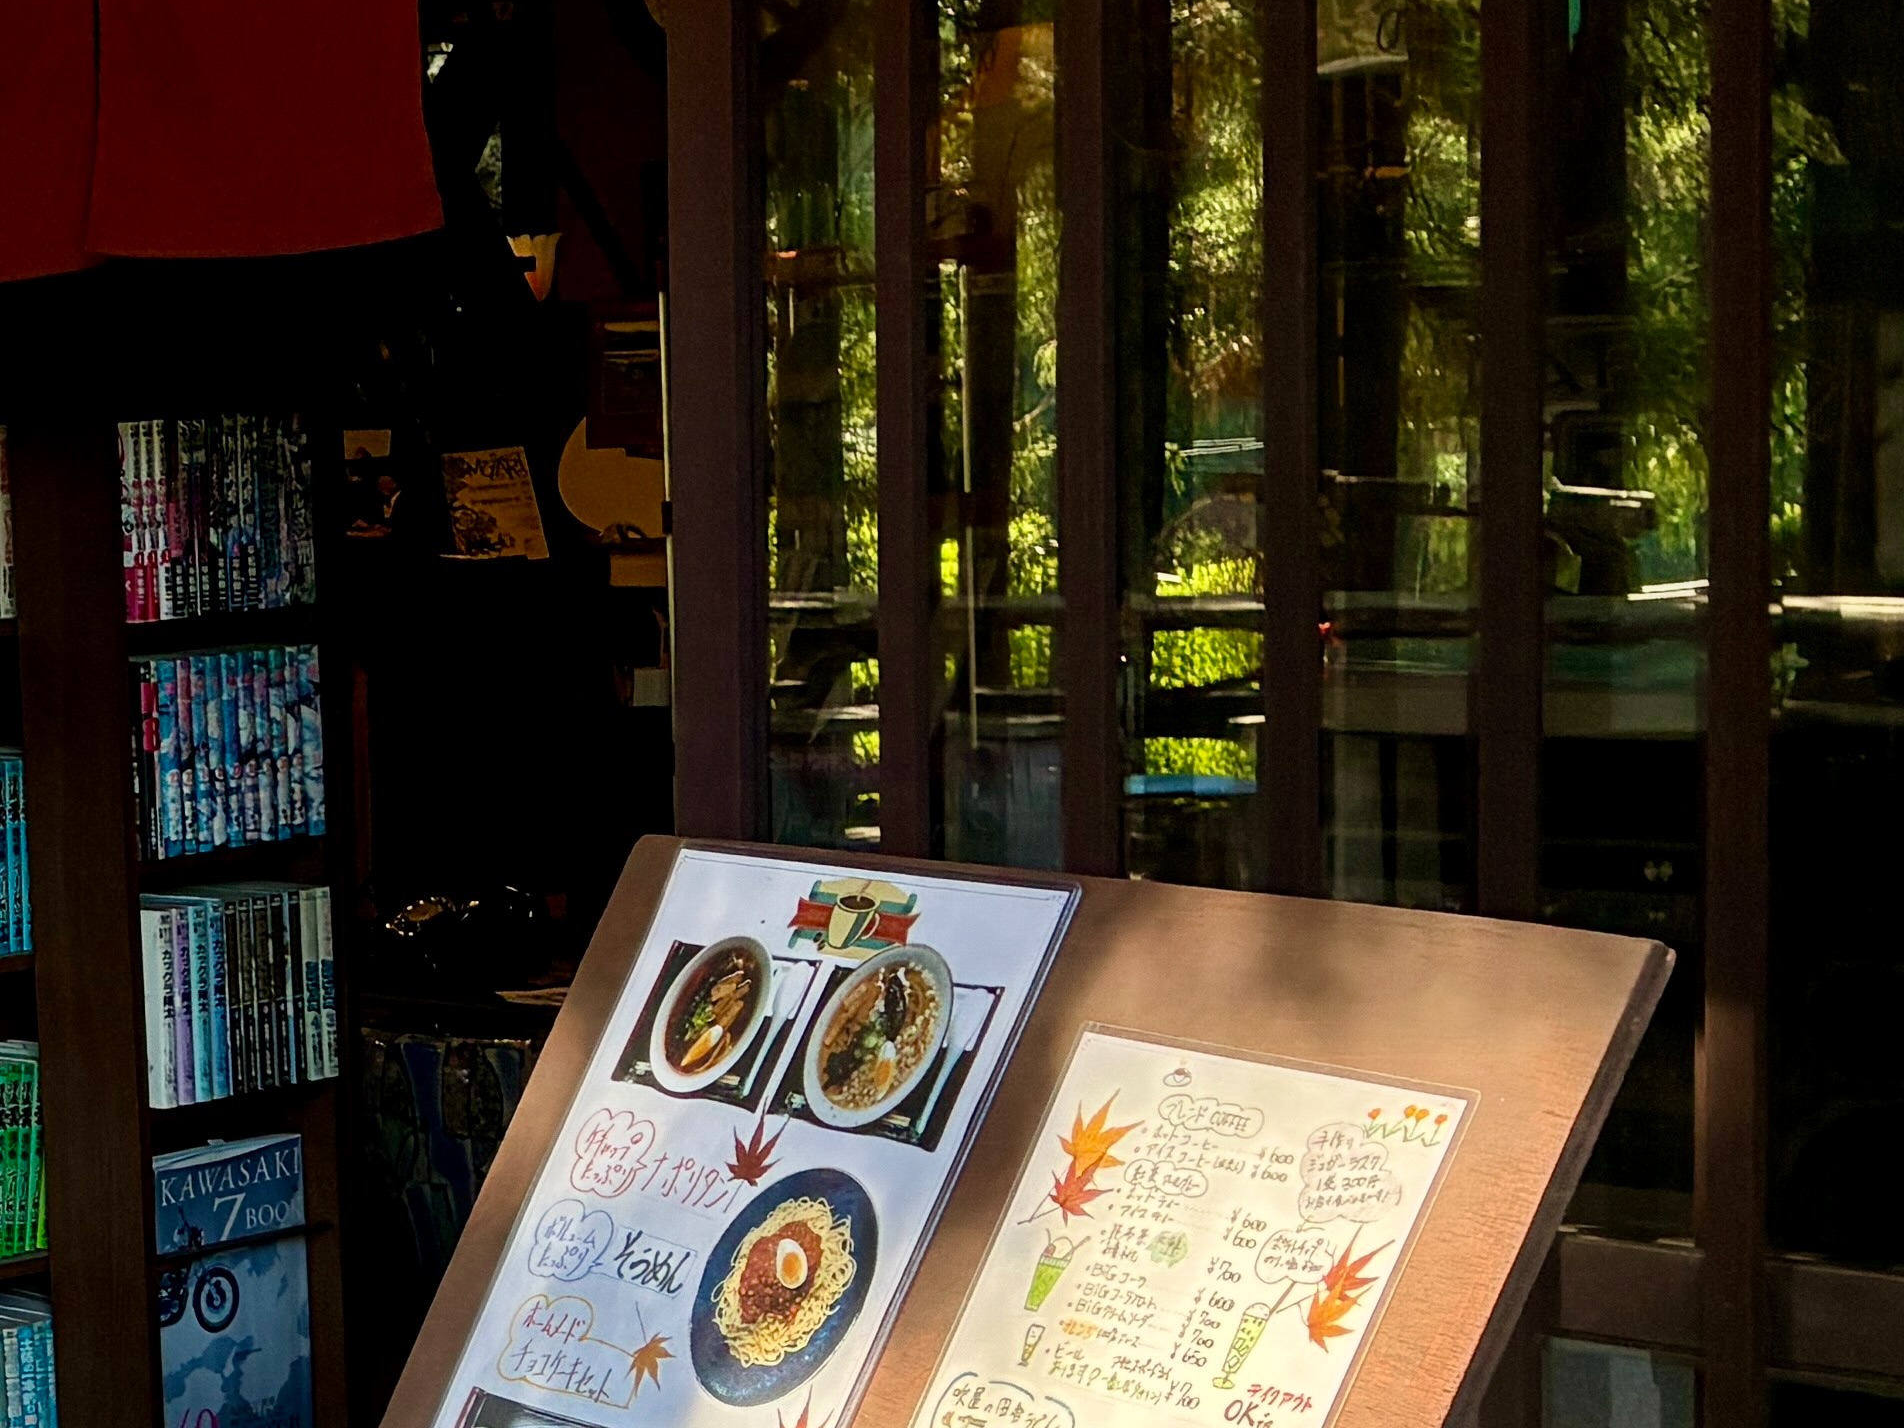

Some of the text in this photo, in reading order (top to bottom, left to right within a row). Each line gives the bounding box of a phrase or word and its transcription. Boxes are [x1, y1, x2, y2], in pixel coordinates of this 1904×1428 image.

[160, 1147, 299, 1207] KAWASAKI
[614, 1229, 690, 1294] そうめん
[511, 1338, 610, 1403] チョコケーキセット
[1247, 1383, 1313, 1413] テイクアウト
